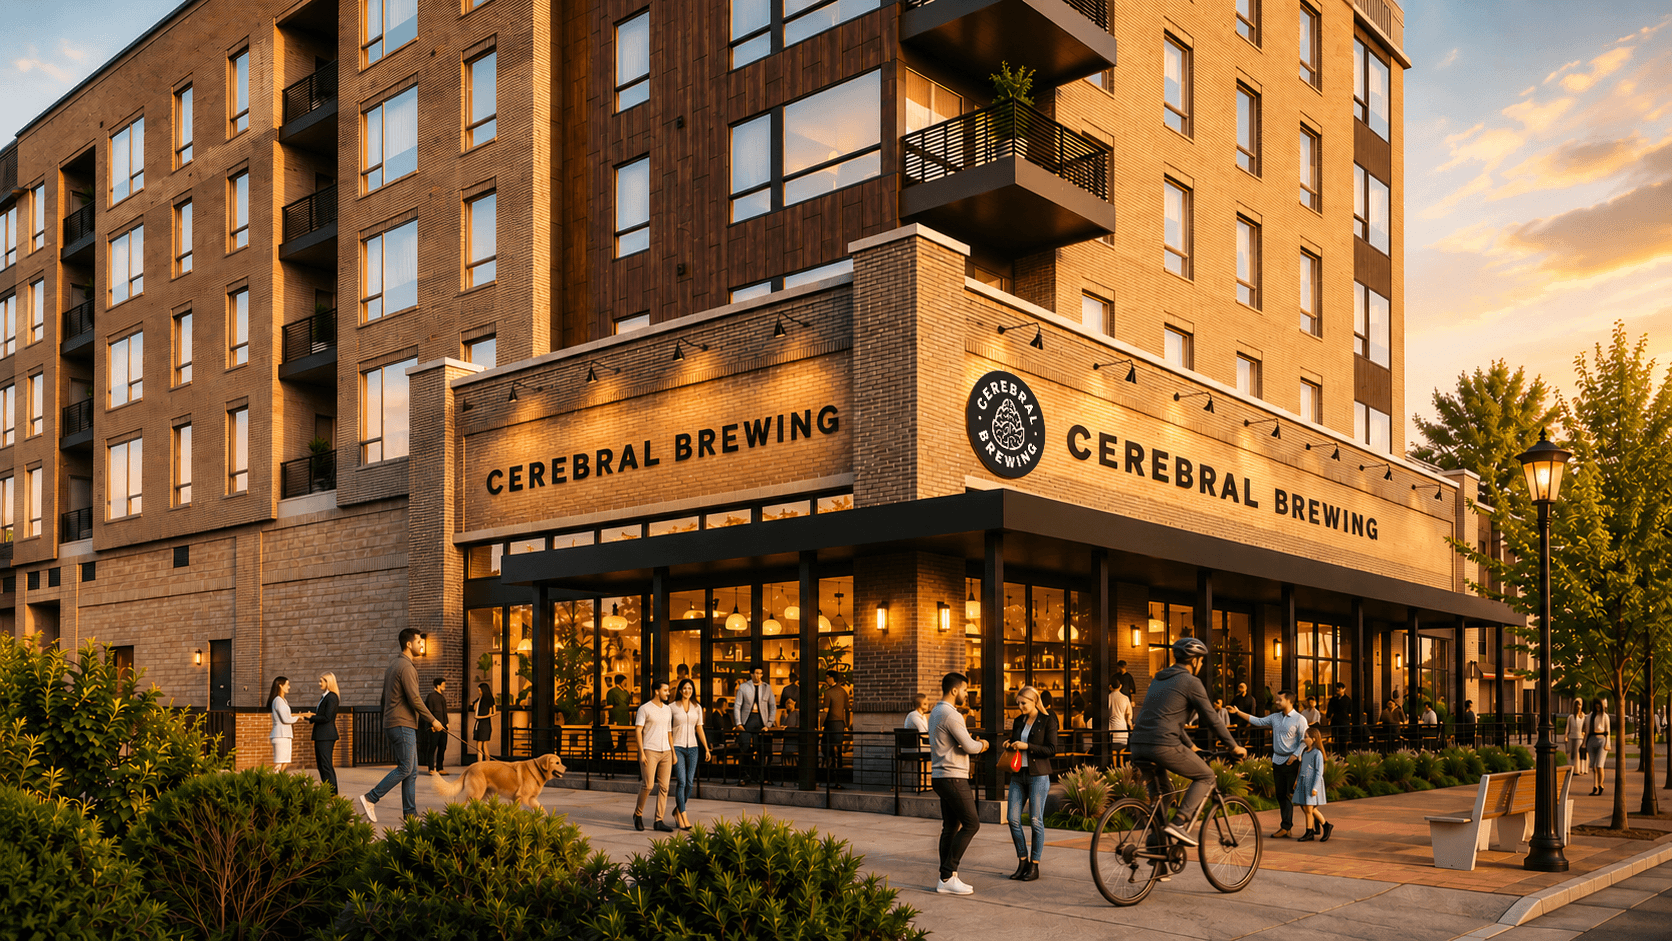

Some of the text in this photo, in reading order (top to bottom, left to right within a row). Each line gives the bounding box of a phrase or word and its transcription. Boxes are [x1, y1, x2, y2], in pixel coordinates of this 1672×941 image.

[977, 379, 1038, 426] CEREBRAL
[486, 405, 840, 496] CEREBRAL BREWING
[978, 429, 1038, 469] BREWING
[1066, 424, 1379, 541] CEREBRAL BREWING
